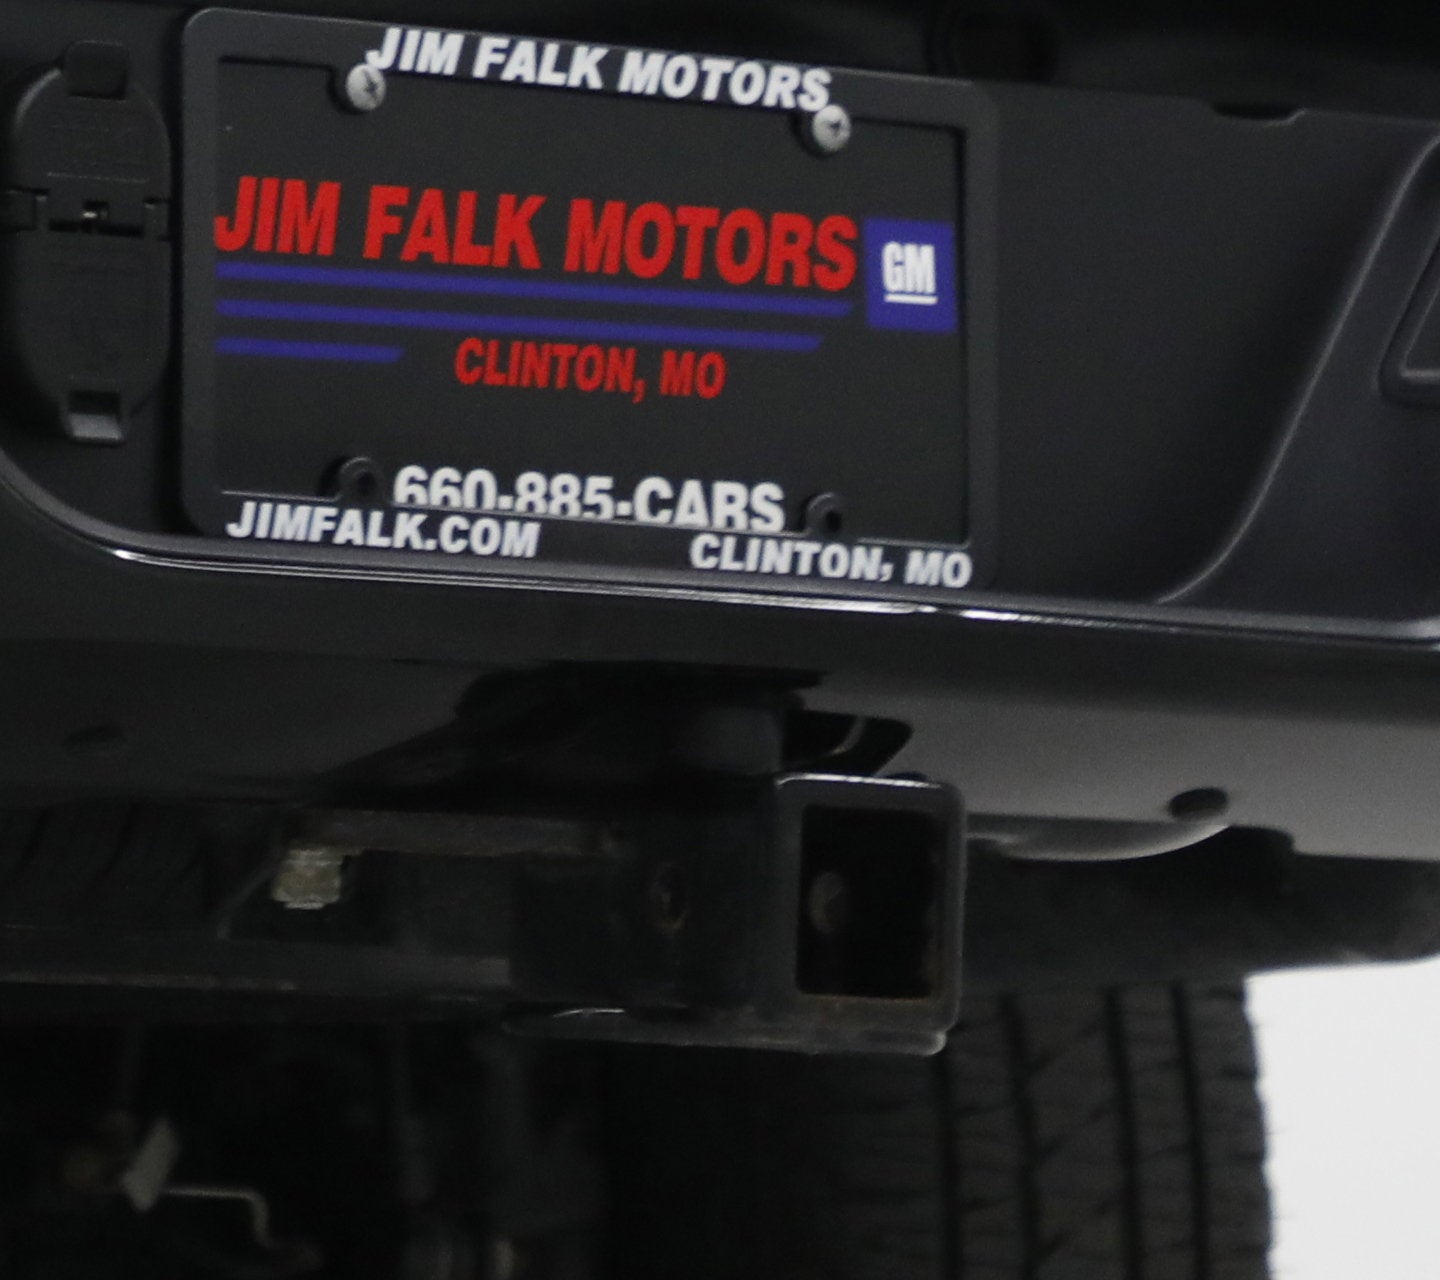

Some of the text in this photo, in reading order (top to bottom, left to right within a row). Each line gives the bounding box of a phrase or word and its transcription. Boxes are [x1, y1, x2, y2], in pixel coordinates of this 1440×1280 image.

[365, 26, 833, 113] JIM FALK MOTORS
[214, 175, 859, 292] JIM FALK MOTORS
[882, 241, 938, 296] GM
[454, 337, 728, 404] CLINTON, MO
[226, 500, 541, 559] JIMFALK.COM
[393, 464, 786, 534] 660-885-CARS
[690, 532, 973, 589] CLINTON, MO
